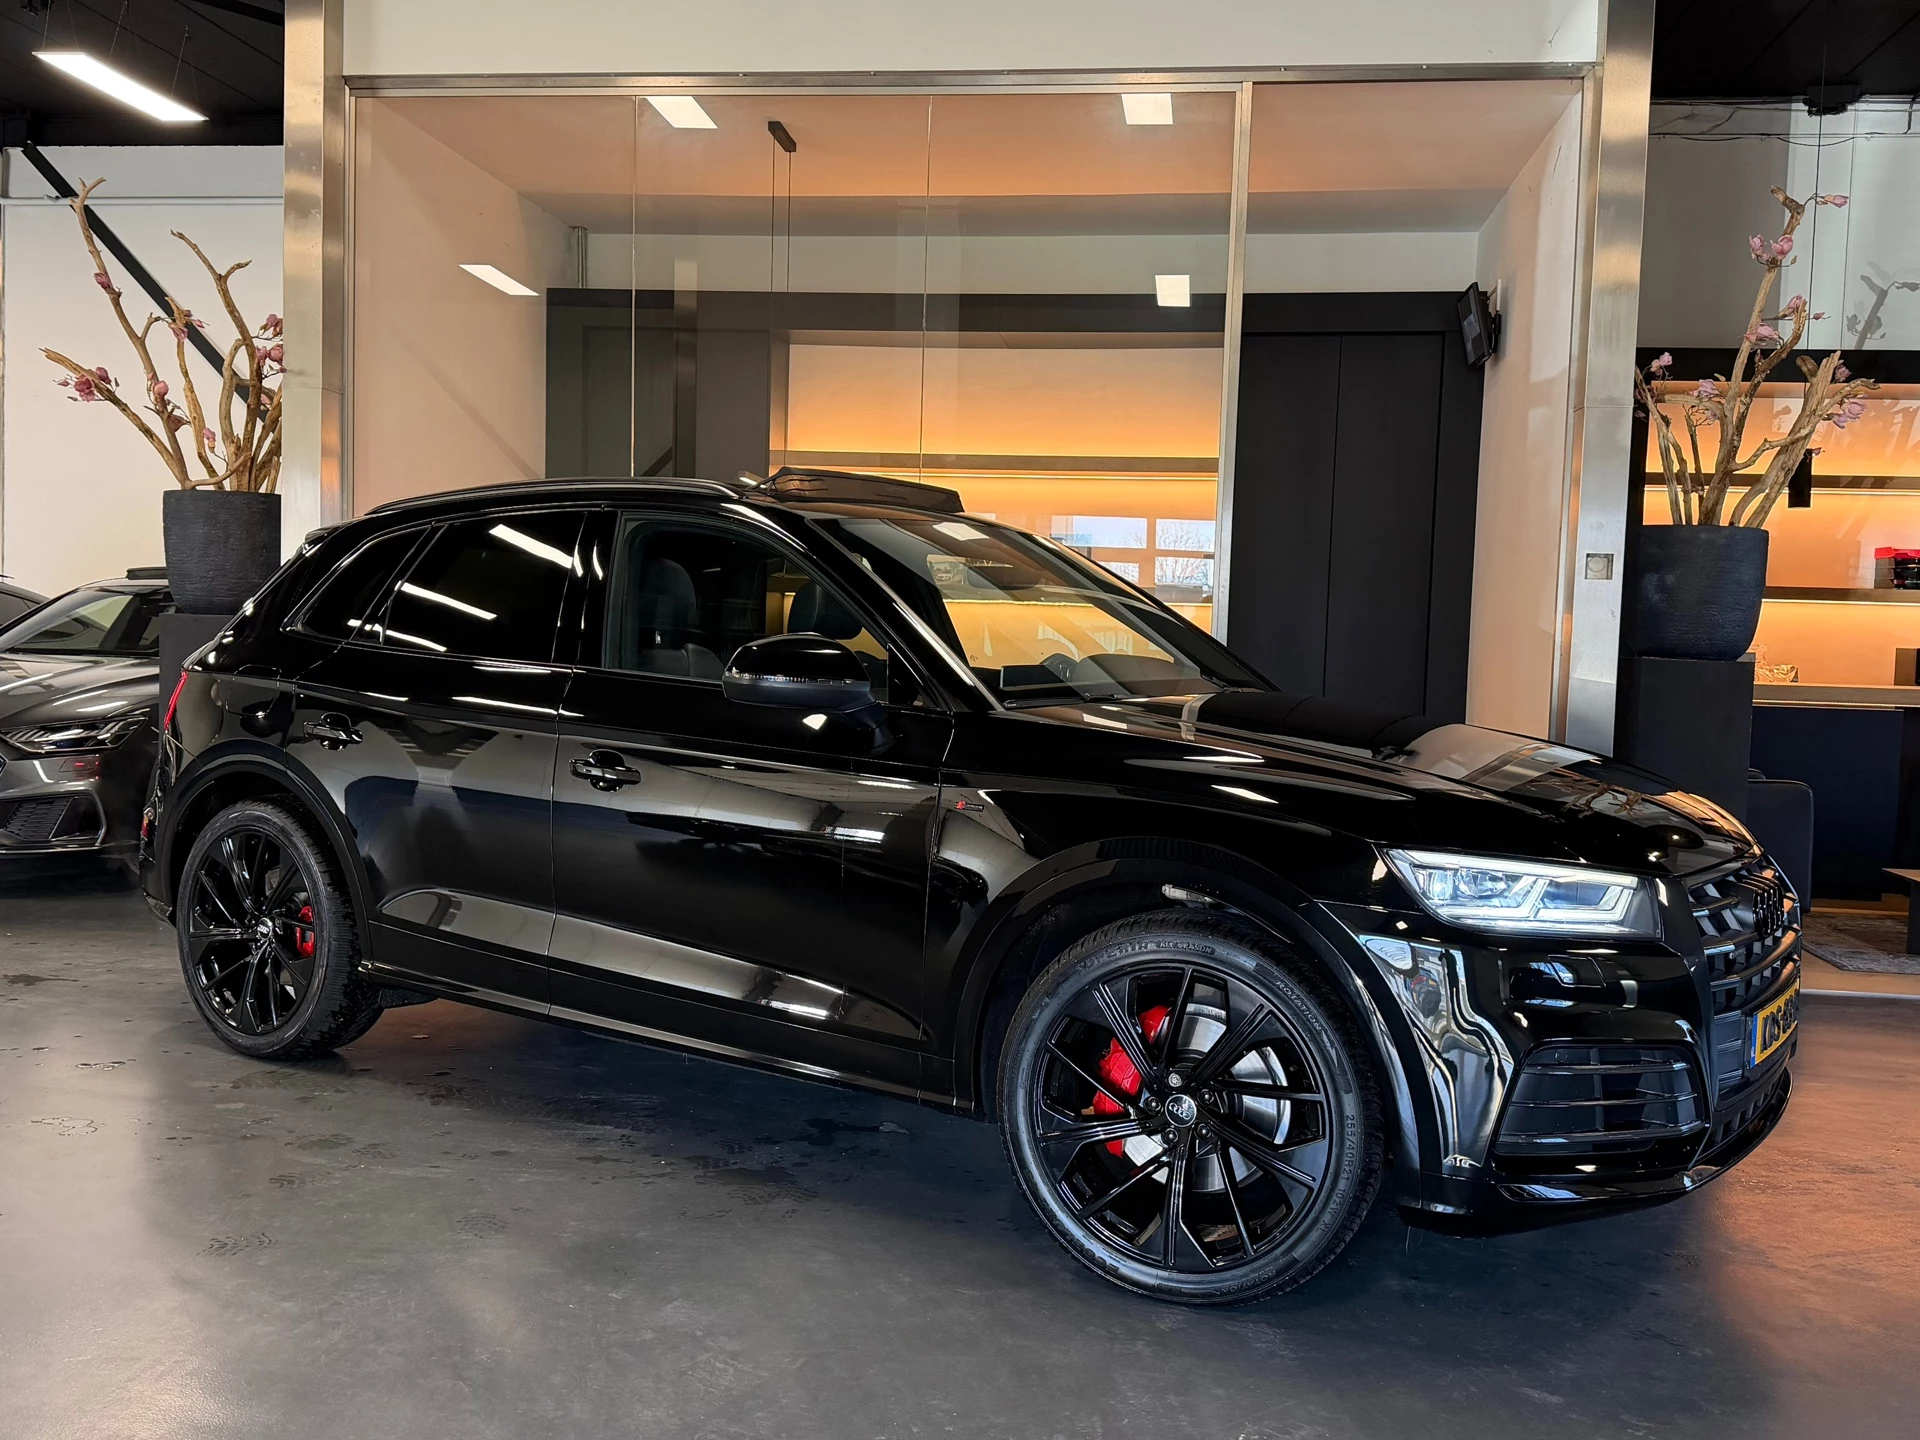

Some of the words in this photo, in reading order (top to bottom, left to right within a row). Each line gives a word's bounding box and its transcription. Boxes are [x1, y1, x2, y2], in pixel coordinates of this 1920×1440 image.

[1177, 942, 1212, 954] SEASON
[1275, 981, 1322, 1031] ROTATION
[1342, 1114, 1356, 1181] 255/40R21
[1328, 1188, 1346, 1217] 102W
[1316, 1220, 1331, 1233] XL
